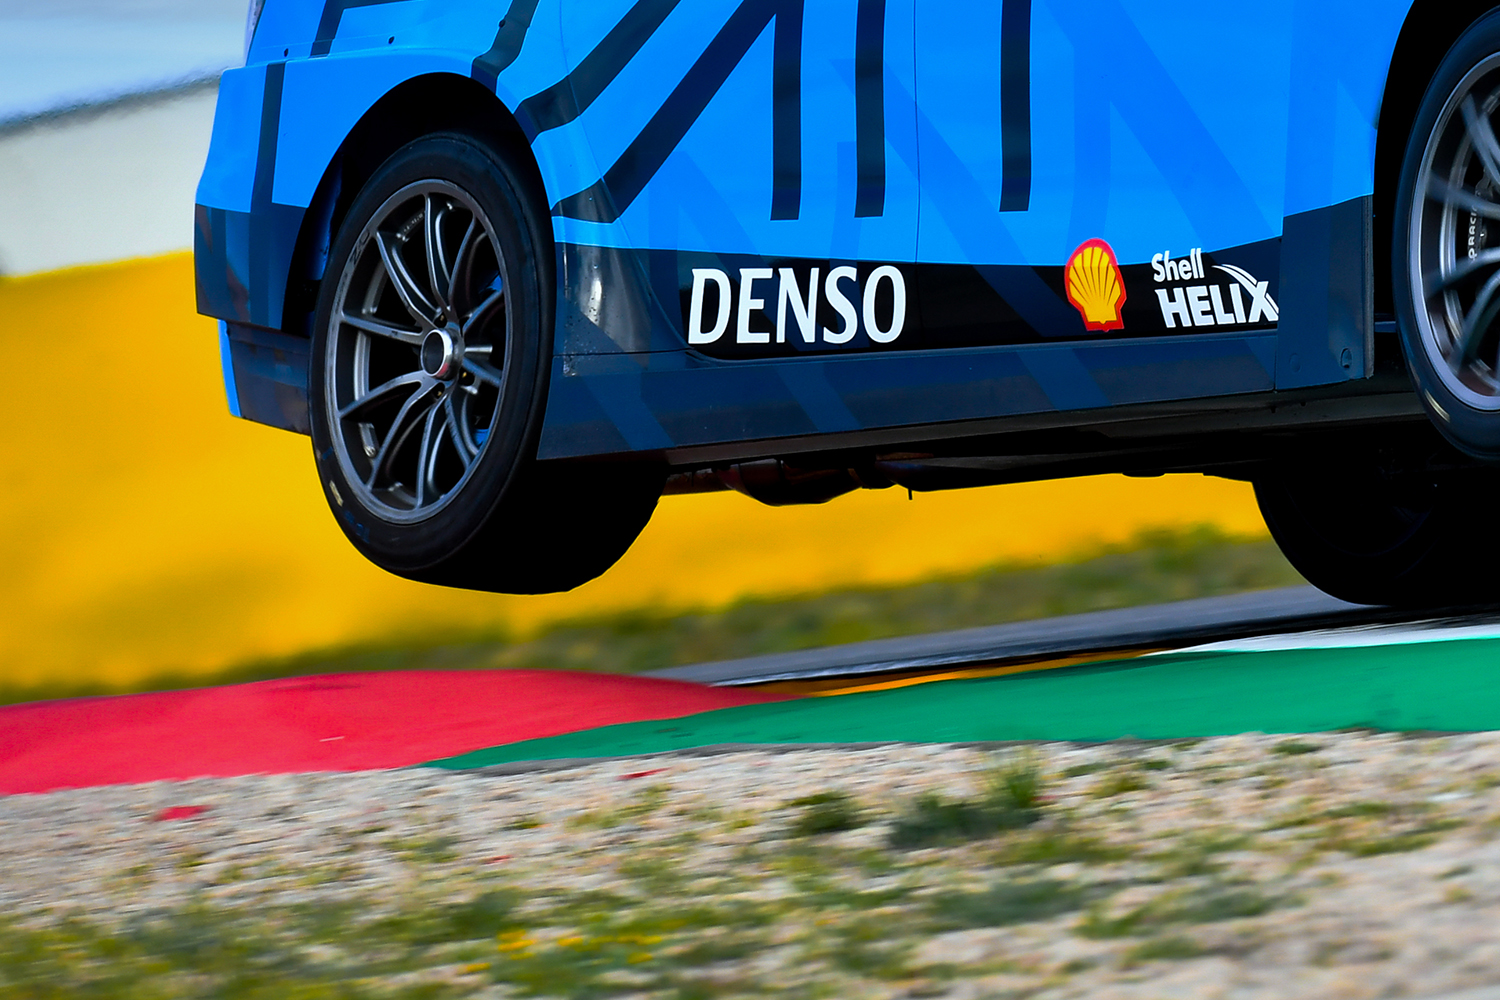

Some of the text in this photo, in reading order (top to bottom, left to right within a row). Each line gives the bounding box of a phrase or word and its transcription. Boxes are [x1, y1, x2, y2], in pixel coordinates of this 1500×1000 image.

[1151, 247, 1205, 283] Shell
[1154, 264, 1280, 329] HELIX
[687, 264, 907, 345] DENSO
